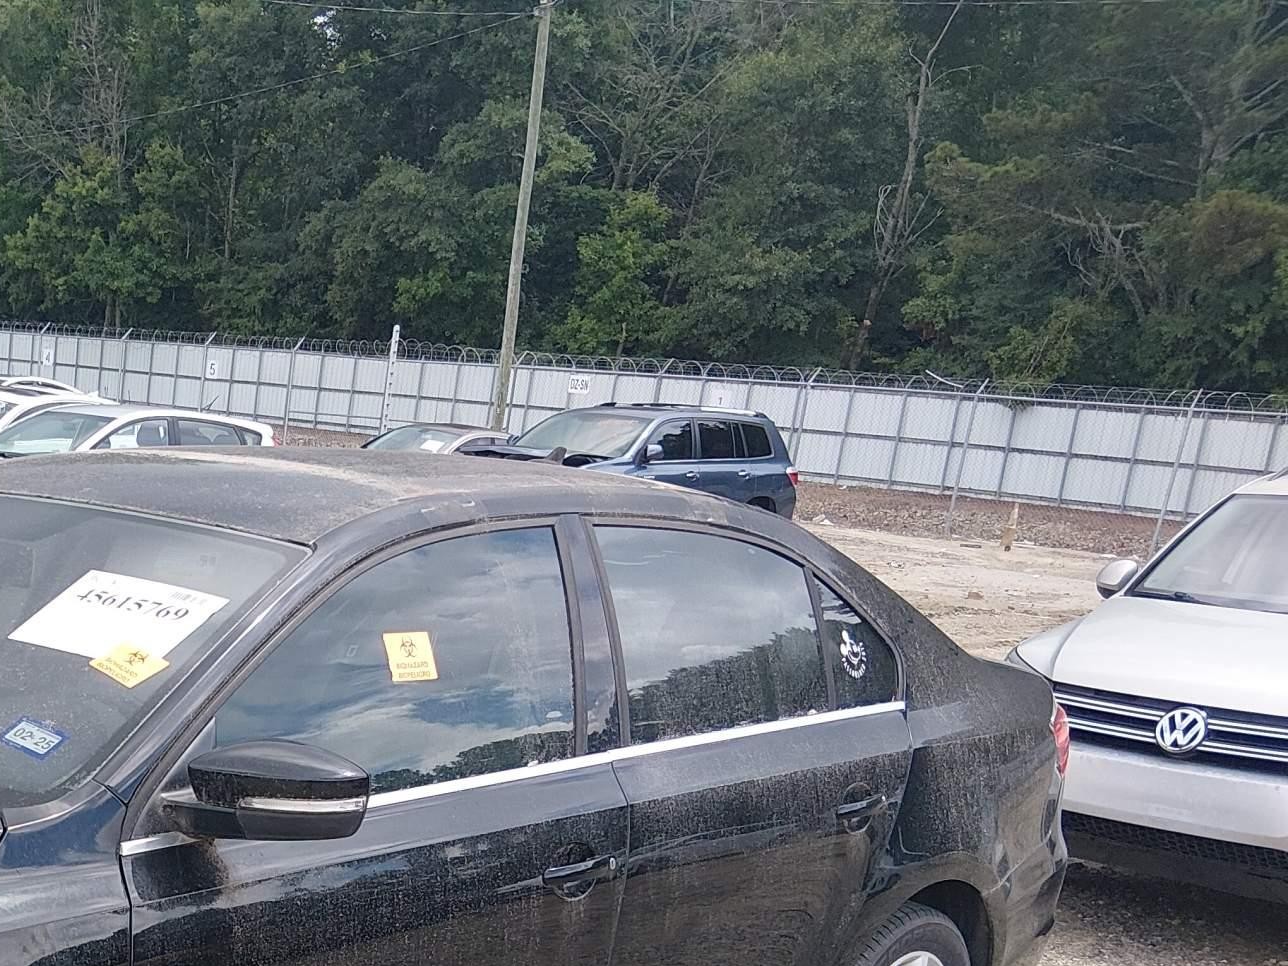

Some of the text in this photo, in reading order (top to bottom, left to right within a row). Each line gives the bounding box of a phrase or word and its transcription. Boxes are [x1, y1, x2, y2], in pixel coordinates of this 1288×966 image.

[45, 351, 51, 363] 4
[209, 363, 216, 376] 5
[76, 588, 190, 621] 45615769
